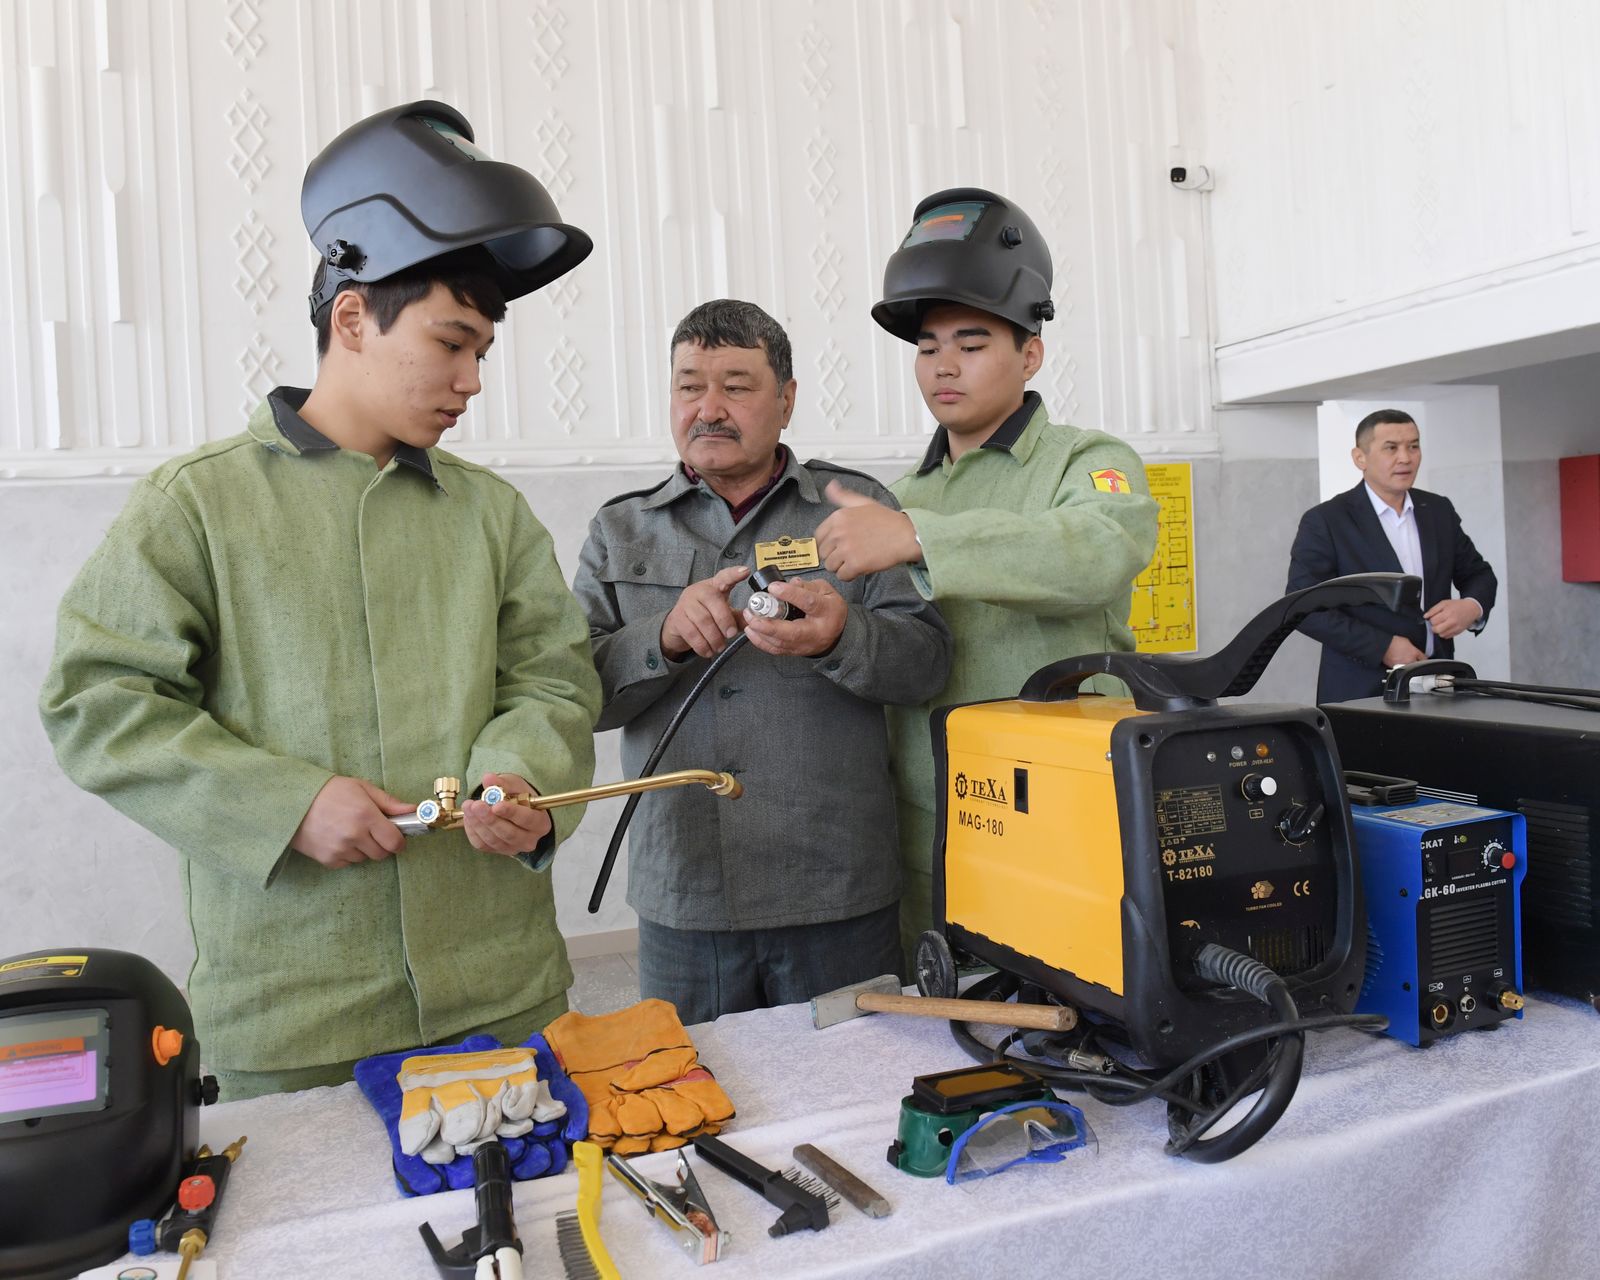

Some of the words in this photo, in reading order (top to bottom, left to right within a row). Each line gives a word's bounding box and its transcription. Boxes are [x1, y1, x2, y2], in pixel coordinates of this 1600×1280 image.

[1229, 760, 1247, 768] POWER
[970, 778, 1006, 801] TEXA
[958, 810, 1004, 837] MAG-180
[1178, 844, 1215, 860] TEXA
[1166, 865, 1213, 881] T-82180
[1456, 884, 1475, 893] INVERTER
[1475, 881, 1491, 889] PLASMA
[1491, 878, 1507, 886] CUTTER
